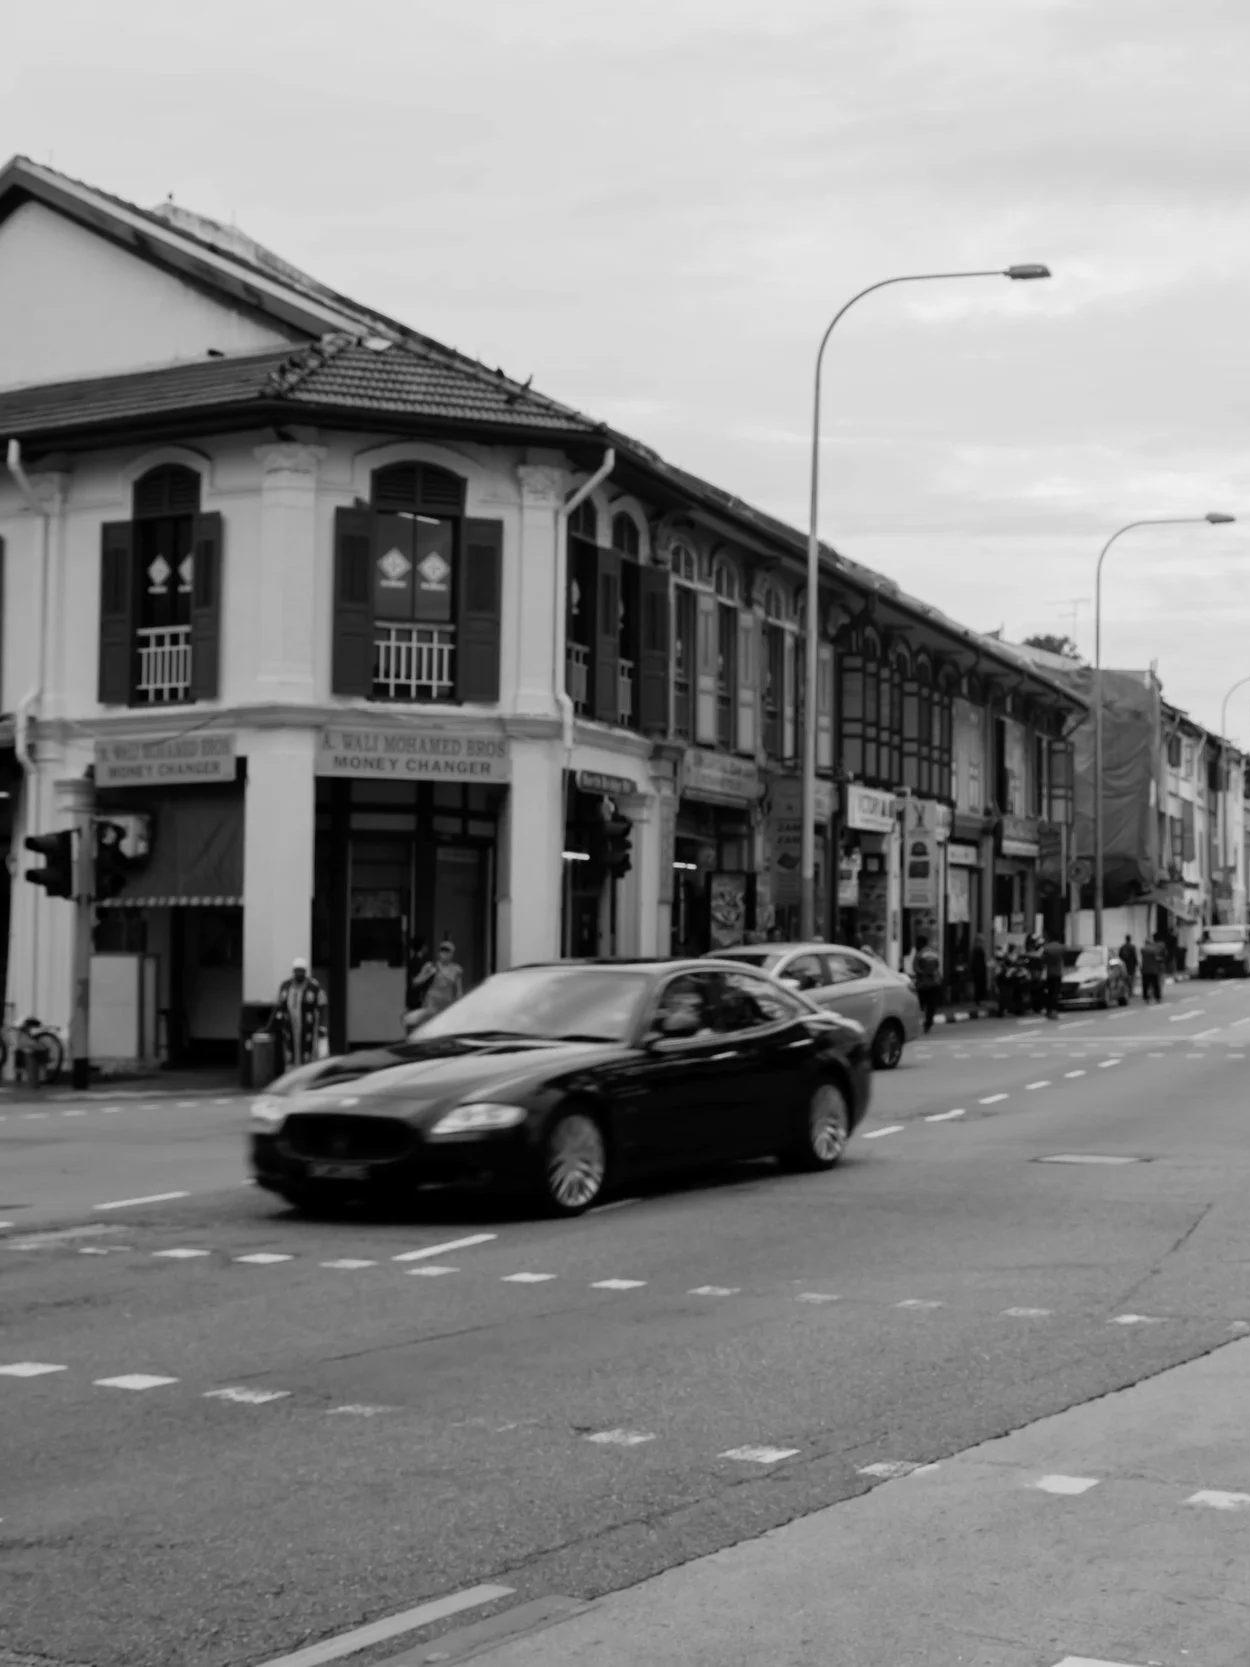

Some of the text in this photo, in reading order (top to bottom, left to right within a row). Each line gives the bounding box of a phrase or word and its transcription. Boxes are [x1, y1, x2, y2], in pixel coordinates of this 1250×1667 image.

[341, 733, 378, 752] WALI
[383, 735, 461, 756] MOHAMED
[466, 739, 506, 758] BROS
[157, 760, 221, 777] CHANGER
[333, 755, 491, 774] MONEY CHANGER
